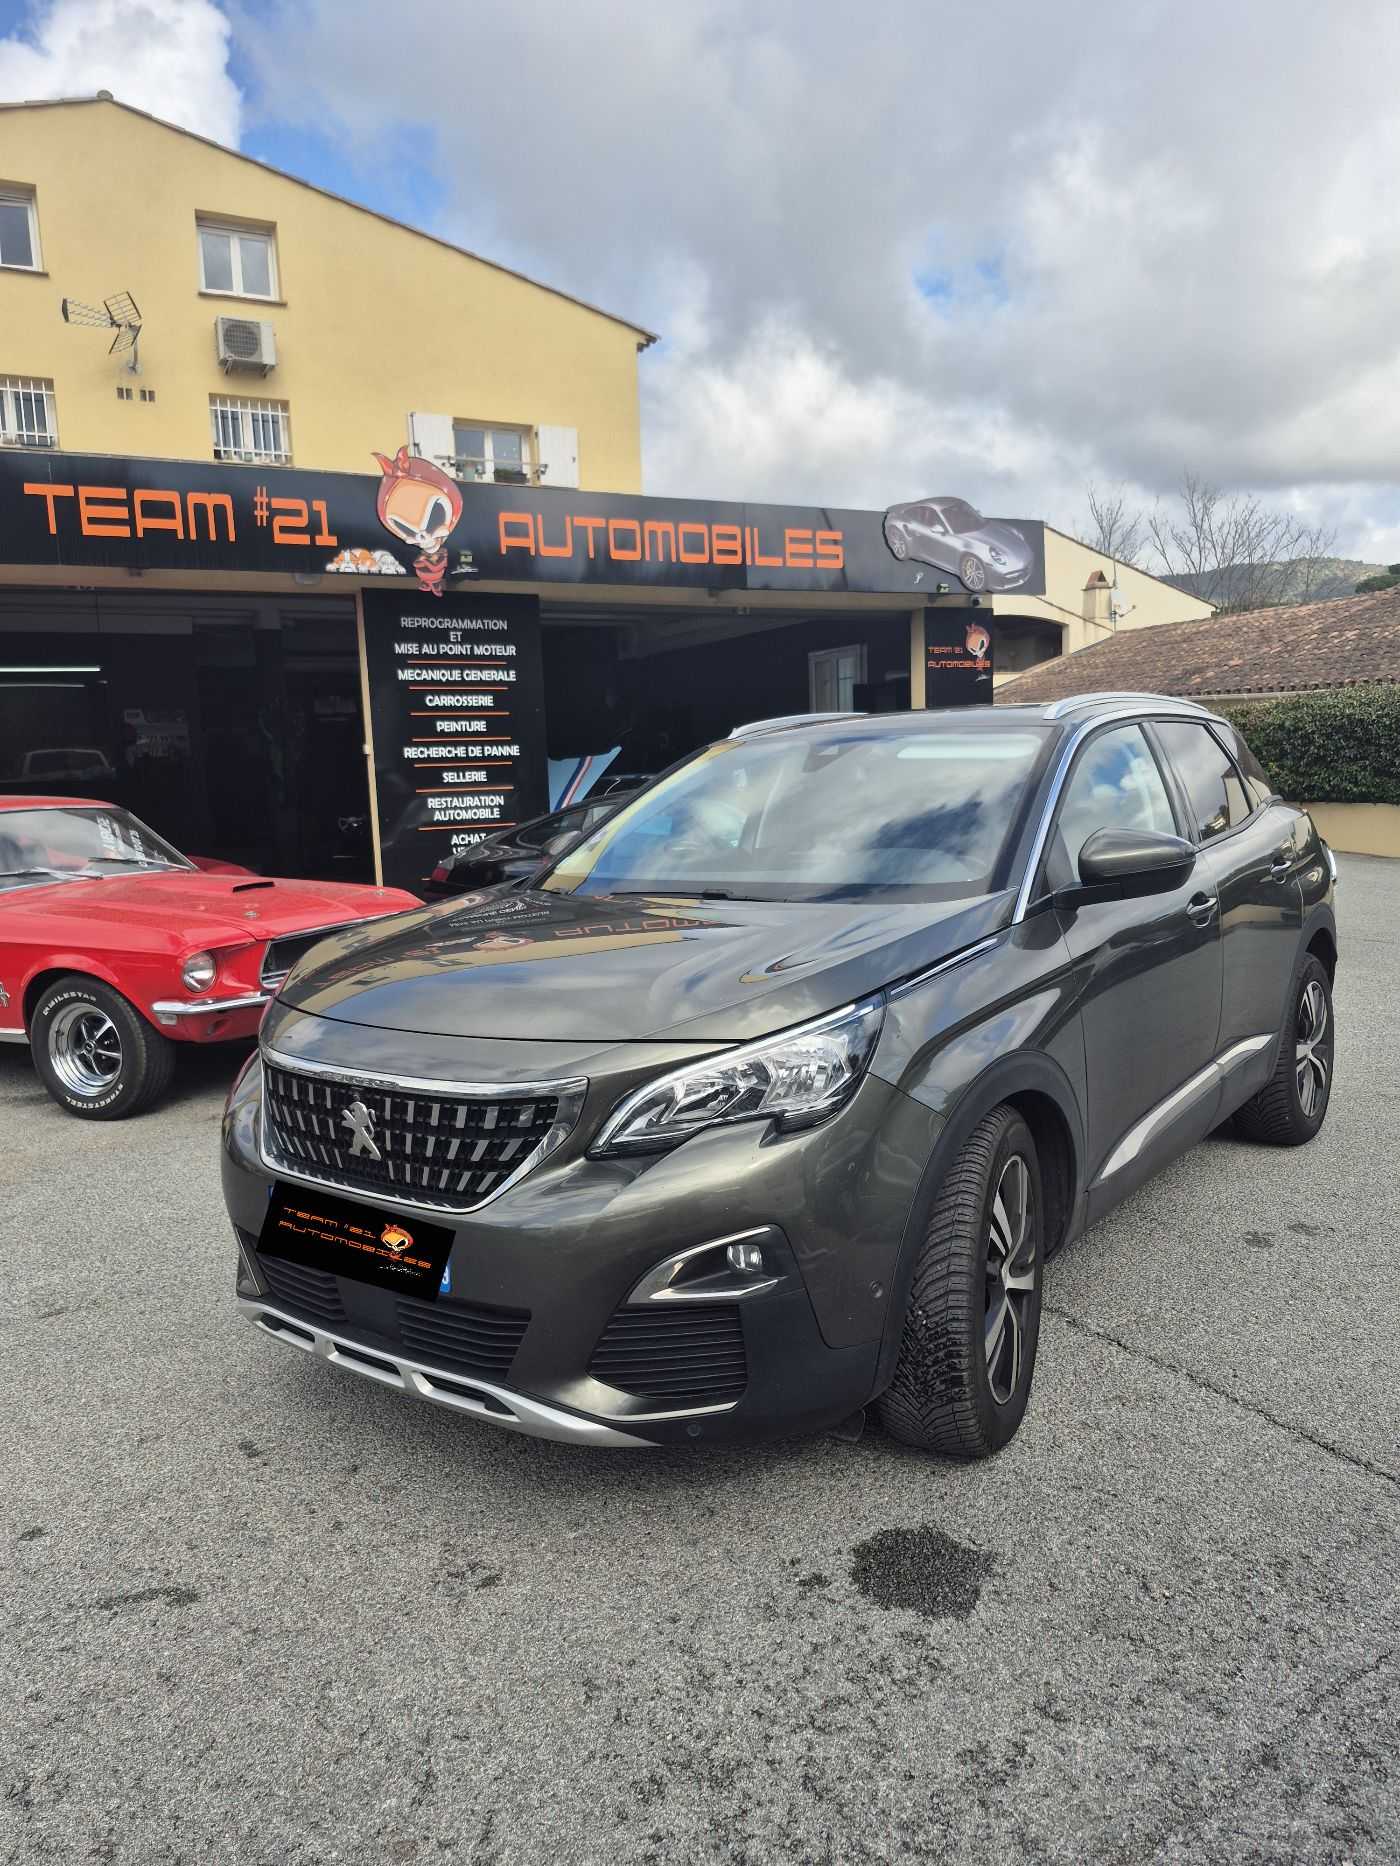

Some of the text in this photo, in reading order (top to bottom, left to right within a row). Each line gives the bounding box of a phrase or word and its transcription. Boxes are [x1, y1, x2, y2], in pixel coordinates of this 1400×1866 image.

[23, 482, 338, 547] TEAM #21
[498, 512, 844, 569] AUTOMOBILES
[400, 617, 508, 630] REPROGRAMMATION
[450, 631, 463, 642] ET
[395, 643, 517, 656] MISE AU POINT MOTEUR
[398, 669, 517, 682] MECANIQUE GENERALE
[426, 695, 495, 707] CARROSSERIE
[436, 720, 488, 733] PEINTURE
[404, 745, 521, 759] RECHERCHE DE PANNE
[442, 770, 488, 783] SELLERIE
[427, 795, 505, 809] RESTAURATION
[433, 807, 501, 821] AUTOMOBILE
[451, 833, 487, 845] ACHAT
